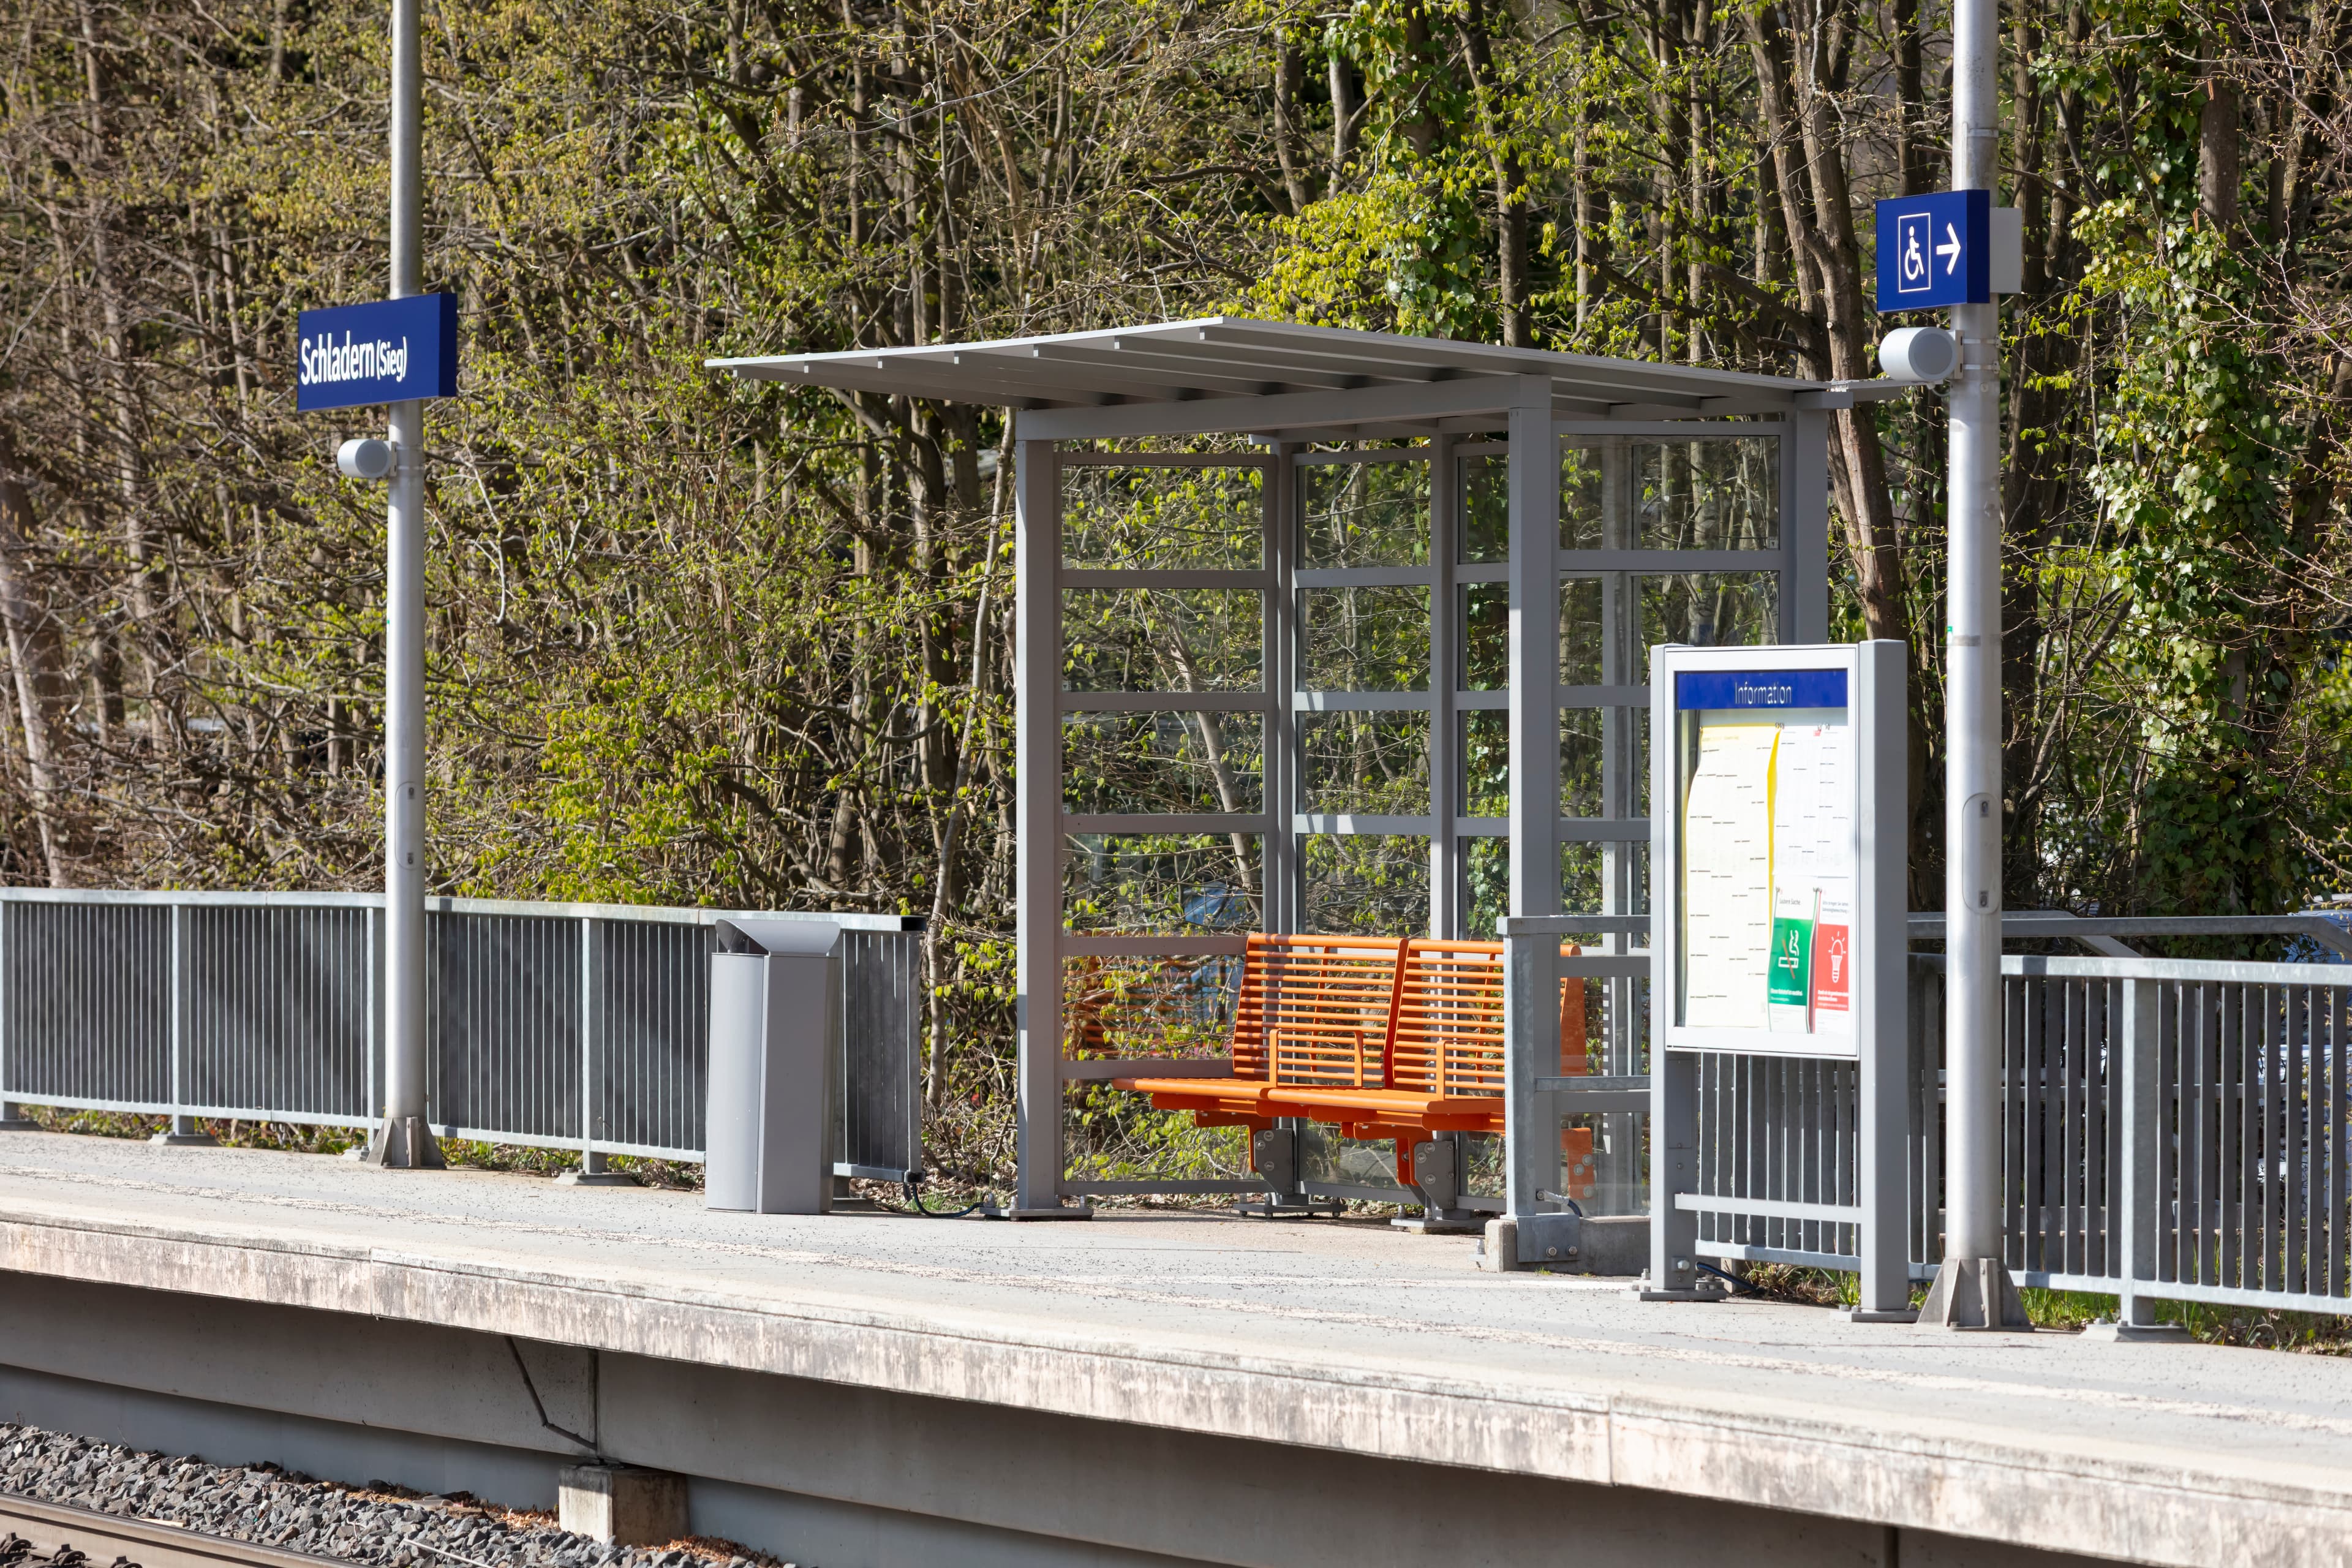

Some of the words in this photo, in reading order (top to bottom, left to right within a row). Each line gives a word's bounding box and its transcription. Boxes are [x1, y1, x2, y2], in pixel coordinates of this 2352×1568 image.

[301, 330, 374, 385] Schladern
[376, 336, 407, 382] (Sieg)
[1735, 681, 1792, 704] Information
